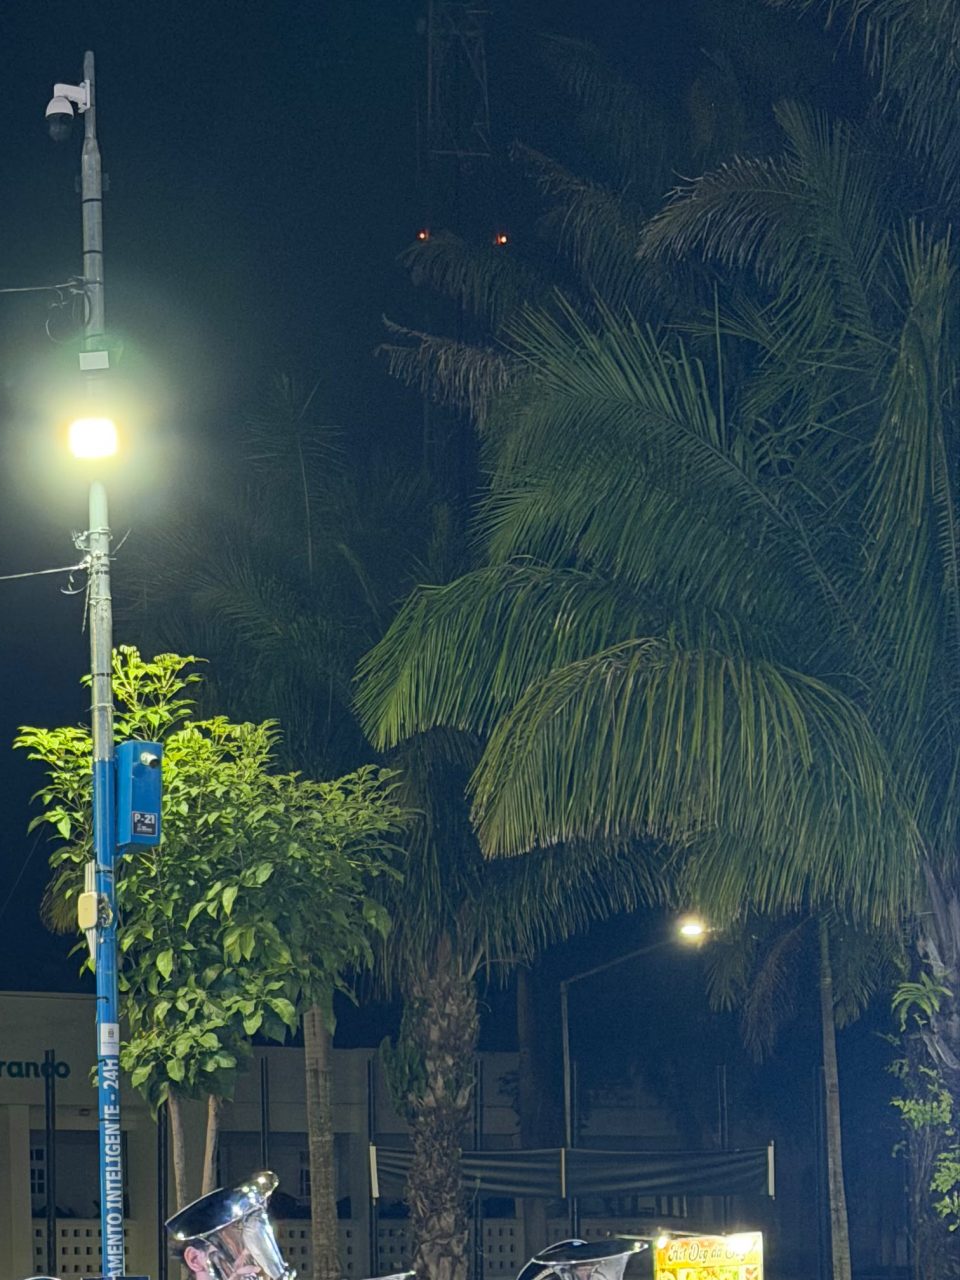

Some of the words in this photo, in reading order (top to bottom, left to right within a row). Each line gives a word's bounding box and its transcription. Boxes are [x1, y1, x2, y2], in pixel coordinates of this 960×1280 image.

[134, 813, 155, 824] P-21
[103, 1059, 120, 1090] 24H
[104, 1104, 121, 1209] INTELIGENTE
